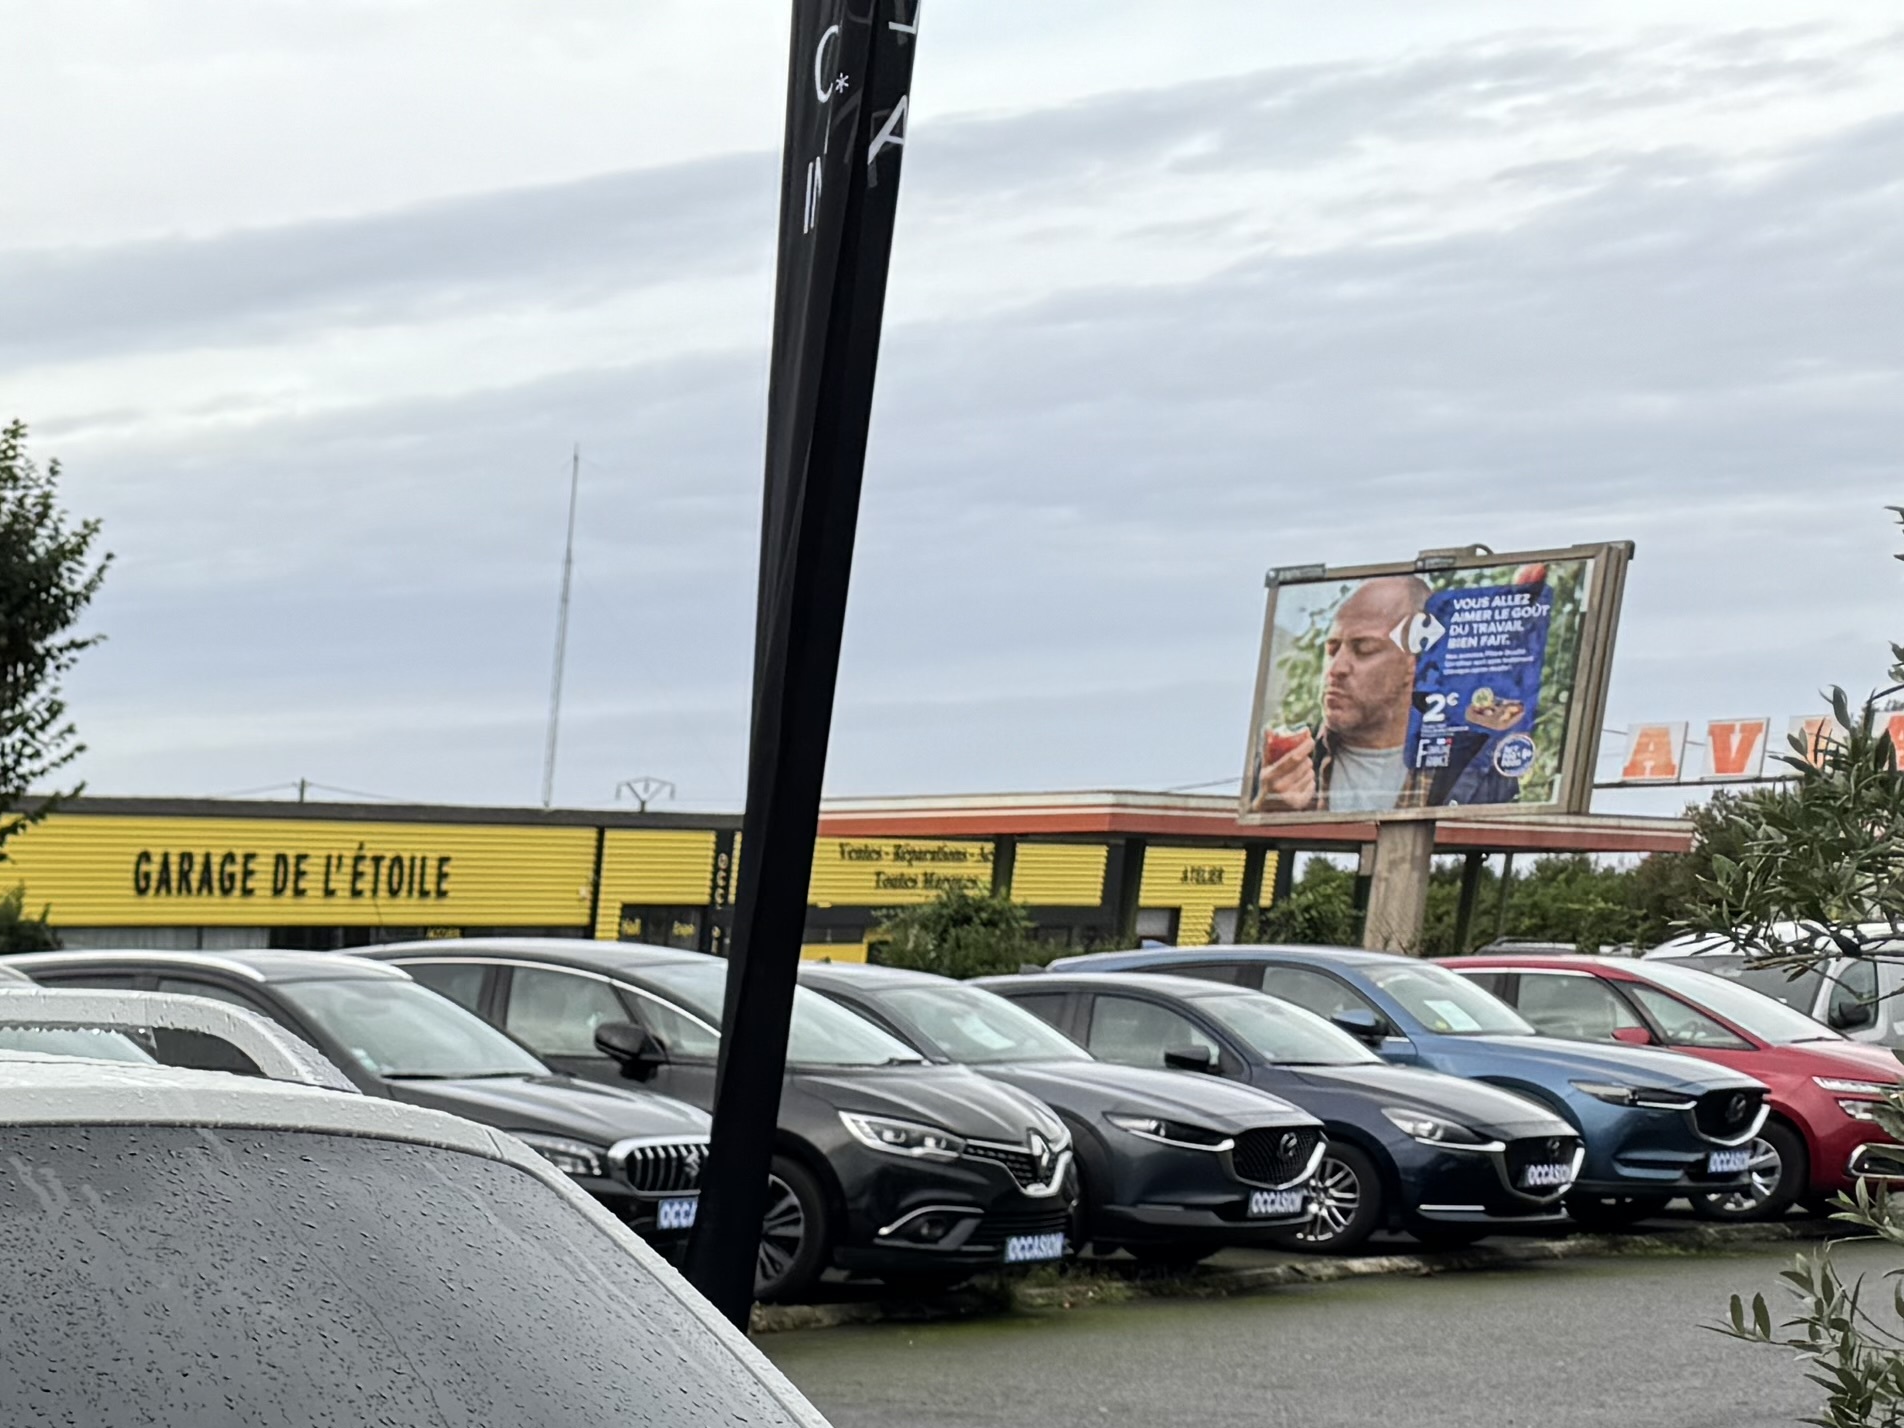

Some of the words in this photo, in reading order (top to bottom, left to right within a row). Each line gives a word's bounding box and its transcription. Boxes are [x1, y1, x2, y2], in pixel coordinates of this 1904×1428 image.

[1453, 596, 1490, 611] VOUS
[1491, 593, 1531, 607] ALLEZ
[1450, 609, 1491, 623] AIMER
[1494, 608, 1510, 621] LE
[1511, 603, 1551, 619] GOÛT
[1449, 624, 1469, 637] DU
[1472, 620, 1524, 634] TRAVAIL
[1447, 635, 1478, 650] BIEN
[134, 850, 258, 897] GARAGE
[272, 852, 309, 897] DE
[323, 841, 452, 898] L'ÉTOILE
[1008, 1232, 1064, 1261] OCCASION
